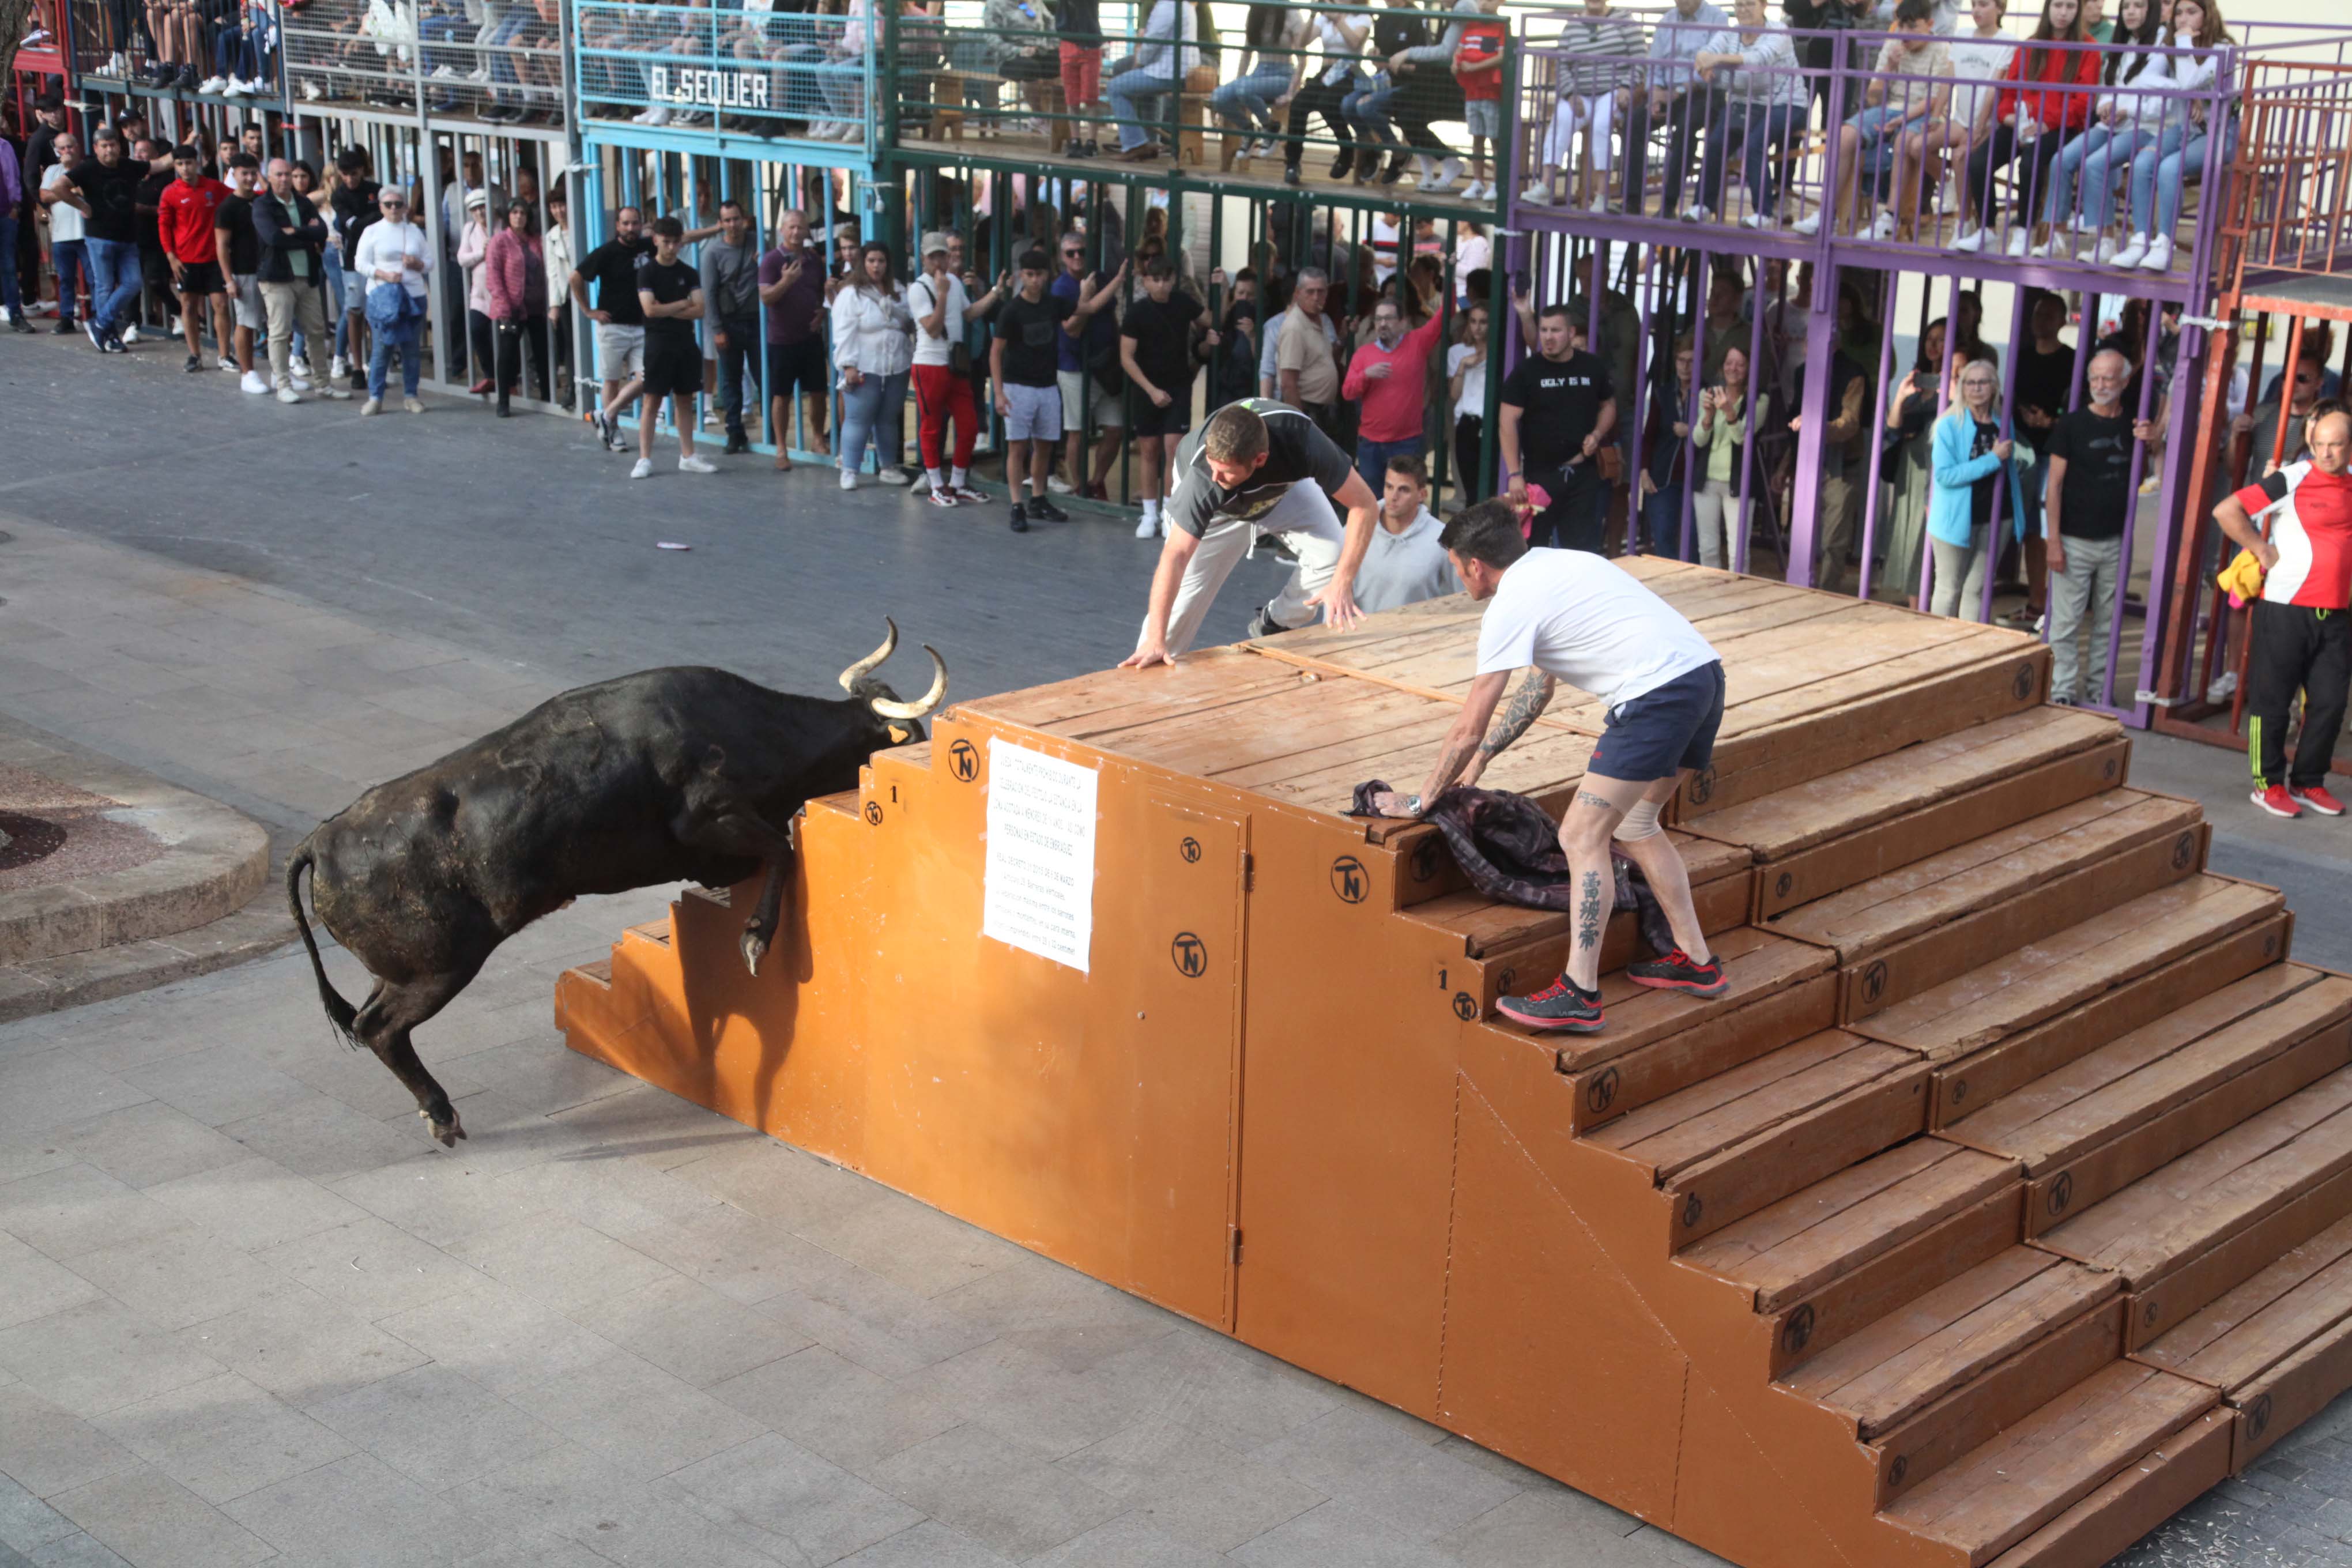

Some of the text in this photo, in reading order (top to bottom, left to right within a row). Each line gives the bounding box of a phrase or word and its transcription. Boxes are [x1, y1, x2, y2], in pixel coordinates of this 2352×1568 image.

[651, 66, 768, 110] EL SEQUER
[889, 785, 898, 804] 1
[1438, 968, 1448, 991] 1
